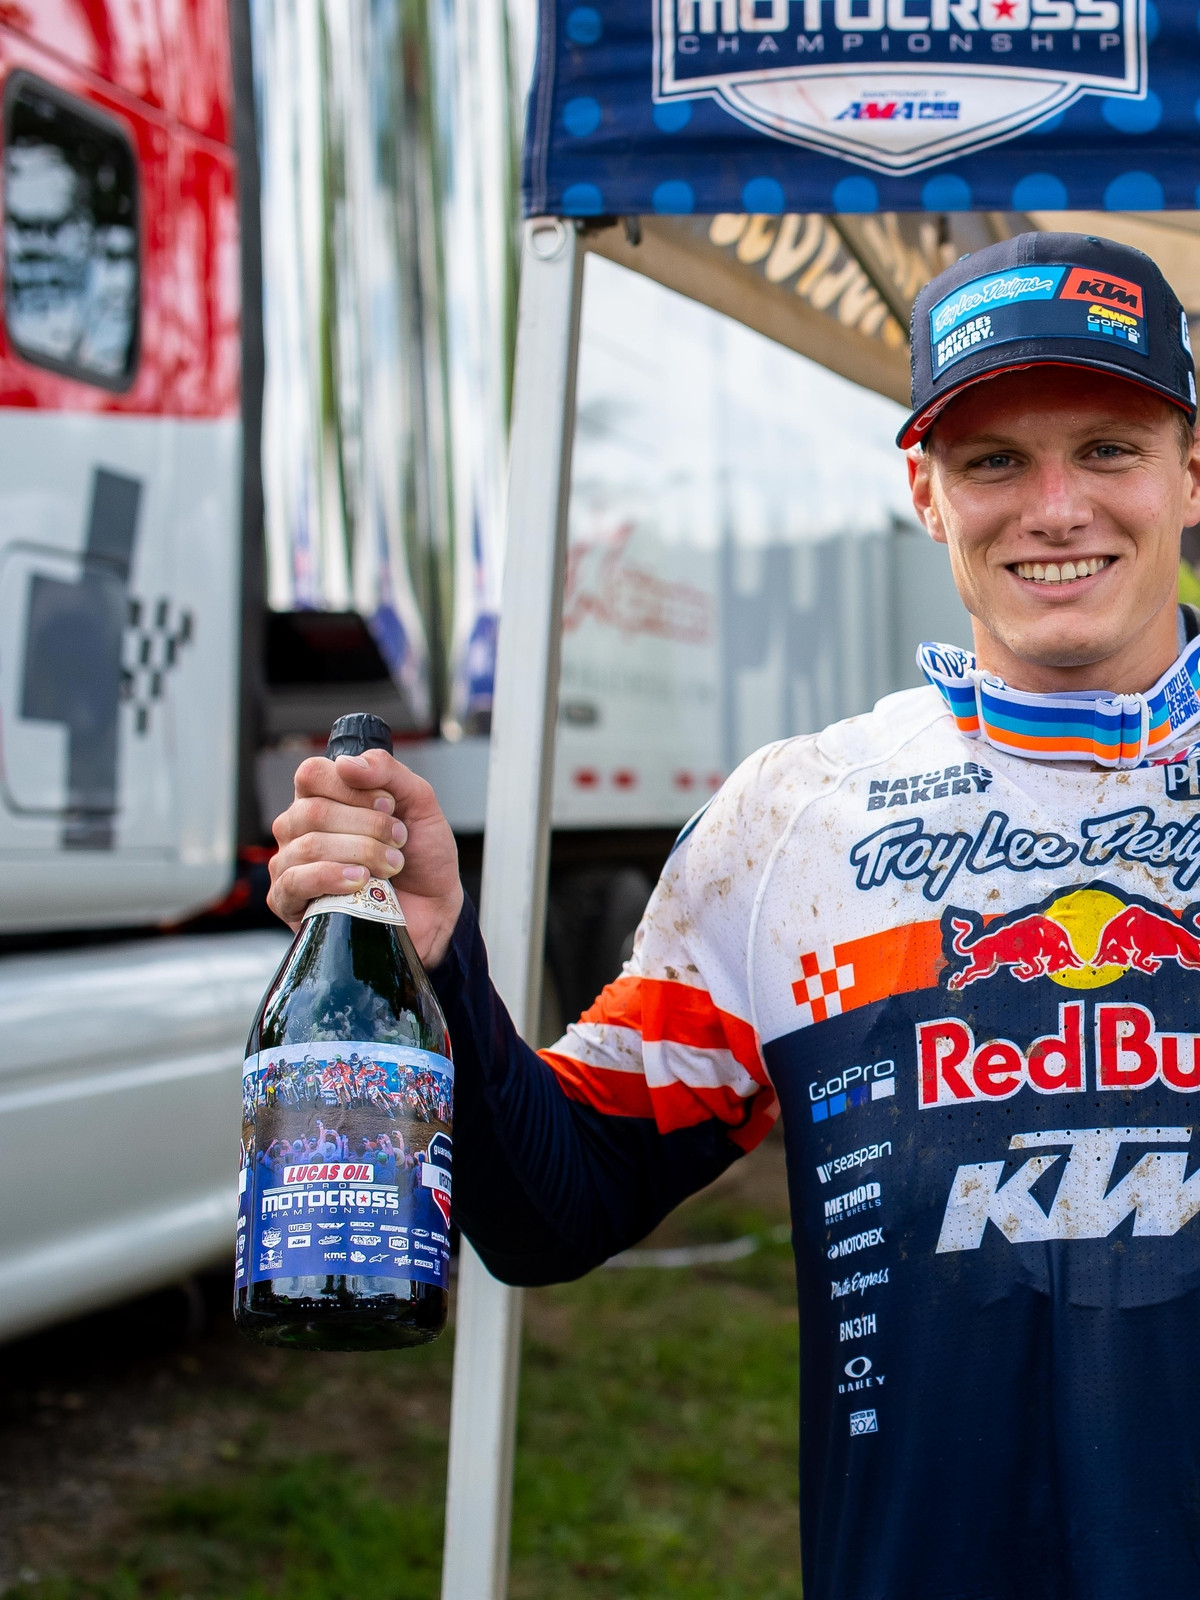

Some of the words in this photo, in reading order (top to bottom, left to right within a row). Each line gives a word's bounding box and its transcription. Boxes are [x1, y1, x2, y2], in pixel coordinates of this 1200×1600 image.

[677, 33, 1122, 54] CHAMPIONSHIP
[1077, 278, 1138, 309] KTM
[1087, 315, 1137, 335] GoPro
[866, 777, 993, 811] BAKERY
[850, 816, 974, 902] Troy
[966, 810, 1079, 875] Lee
[915, 1000, 1085, 1111] Red
[808, 1059, 895, 1101] GoPro
[834, 1141, 892, 1174] seaspan
[286, 1164, 341, 1183] LUCAS
[342, 1164, 371, 1181] OIL
[261, 1190, 399, 1213] MOTOCROSS
[261, 1207, 399, 1221] CHAMPIONSHIP
[824, 1182, 881, 1218] METHOD
[825, 1213, 845, 1226] RACE
[846, 1199, 882, 1218] WHEELS
[289, 1223, 312, 1233] WPS
[838, 1227, 886, 1257] MOTOREX
[391, 1239, 407, 1248] 100%
[839, 1313, 877, 1342] BN3TH
